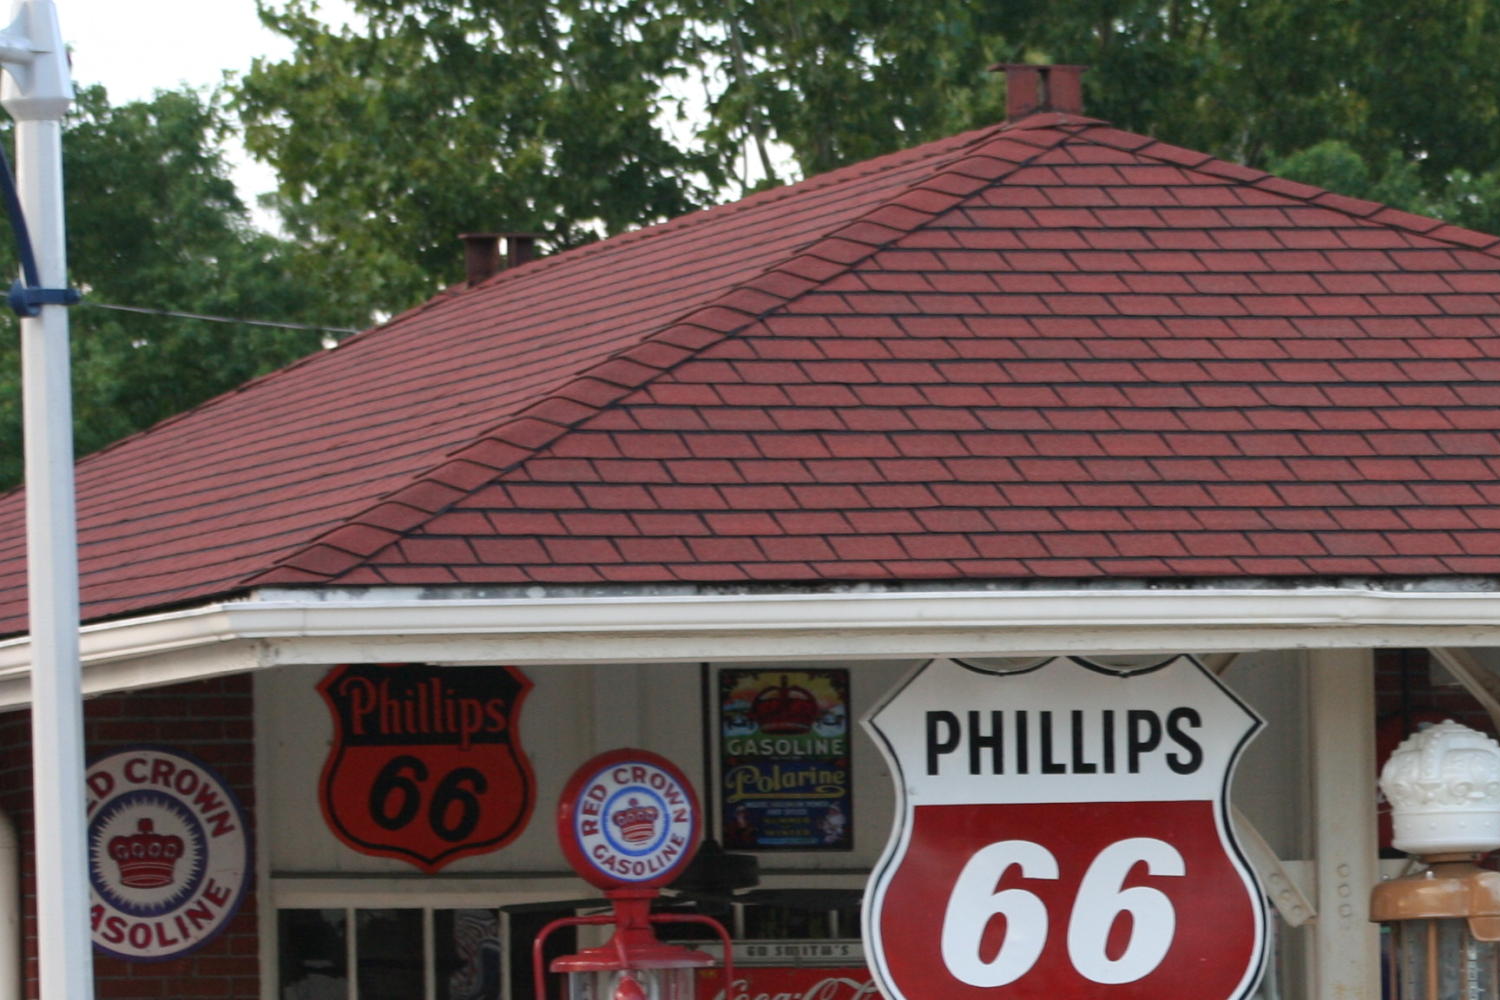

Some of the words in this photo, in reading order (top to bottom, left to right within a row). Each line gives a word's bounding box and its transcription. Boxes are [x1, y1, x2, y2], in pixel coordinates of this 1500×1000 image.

[339, 675, 508, 750] Phillips
[727, 739, 844, 756] GASOLINE
[926, 707, 1203, 775] PHILLIPS
[123, 758, 235, 838] CROWN
[368, 755, 488, 843] 66
[581, 784, 608, 836] RED
[612, 766, 688, 823] CROWN
[726, 764, 846, 803] Polarine
[592, 833, 685, 875] GASOLINE
[91, 878, 232, 949] ASOLINE
[941, 837, 1187, 988] 66
